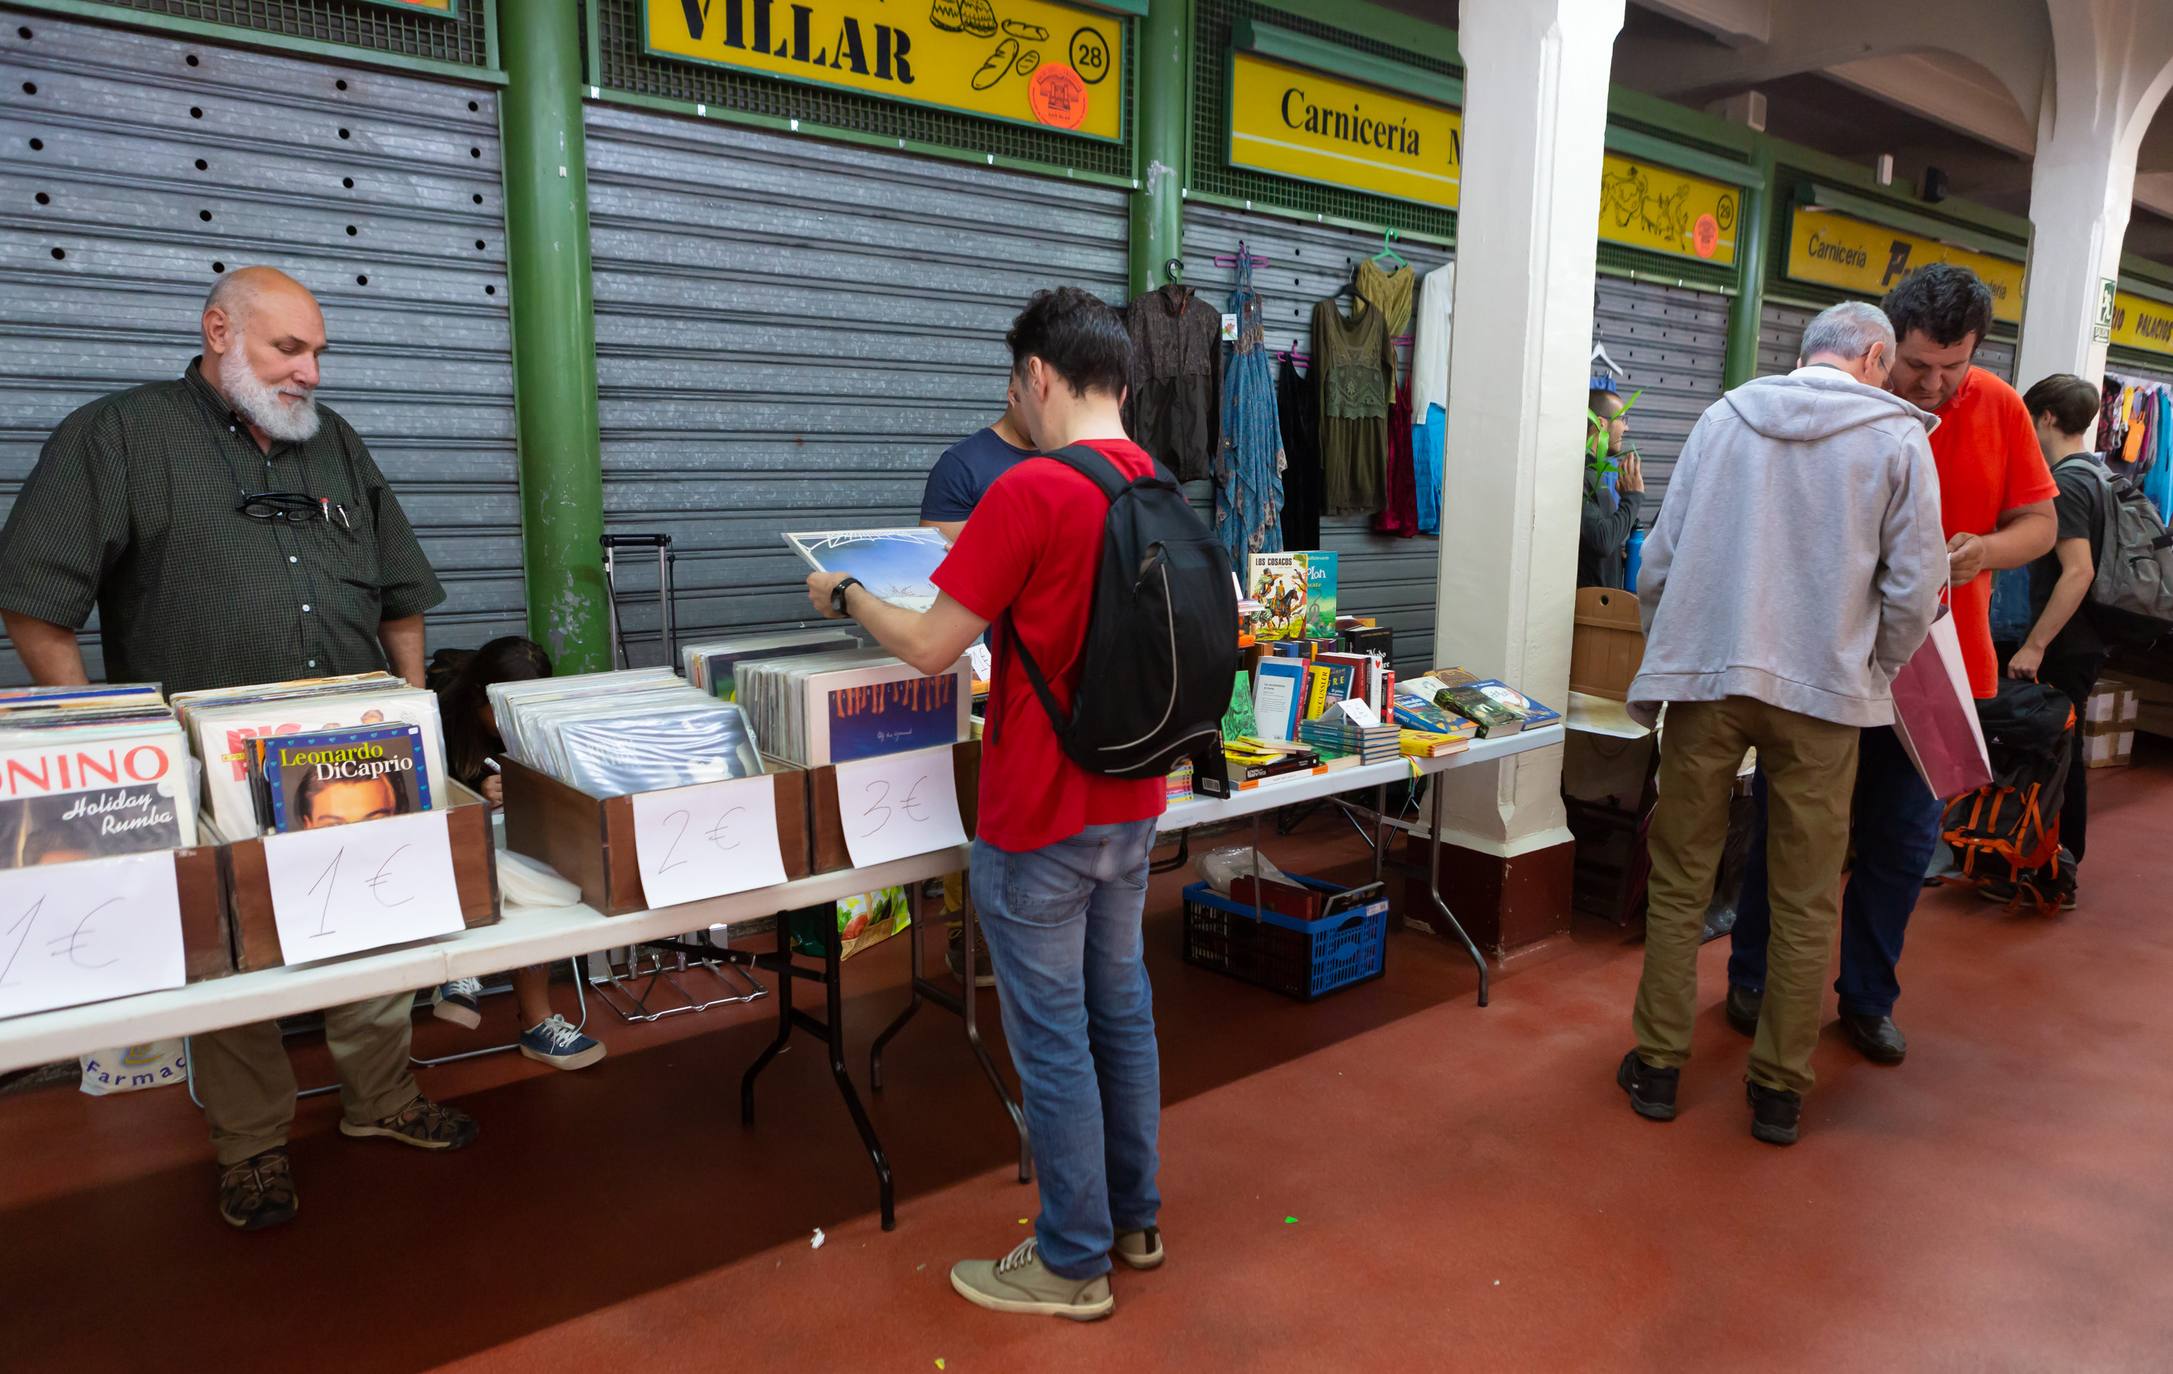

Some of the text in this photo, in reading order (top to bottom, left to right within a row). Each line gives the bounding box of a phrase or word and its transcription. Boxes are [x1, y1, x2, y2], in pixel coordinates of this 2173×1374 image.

[680, 0, 915, 84] VILLAR
[1079, 44, 1102, 68] 28
[1281, 87, 1420, 157] Carnicería
[1808, 232, 1867, 269] Carnicería
[1255, 557, 1293, 566] LOS COSACOS
[0, 745, 169, 796] NINO
[279, 742, 383, 767] Leonardo
[316, 754, 413, 781] DiCaprio
[62, 789, 152, 821] Holiday
[101, 806, 173, 836] Rumba
[861, 775, 930, 838] 3 €
[658, 806, 746, 874] 2 €
[308, 843, 415, 938] 1 €
[46, 896, 126, 969] €
